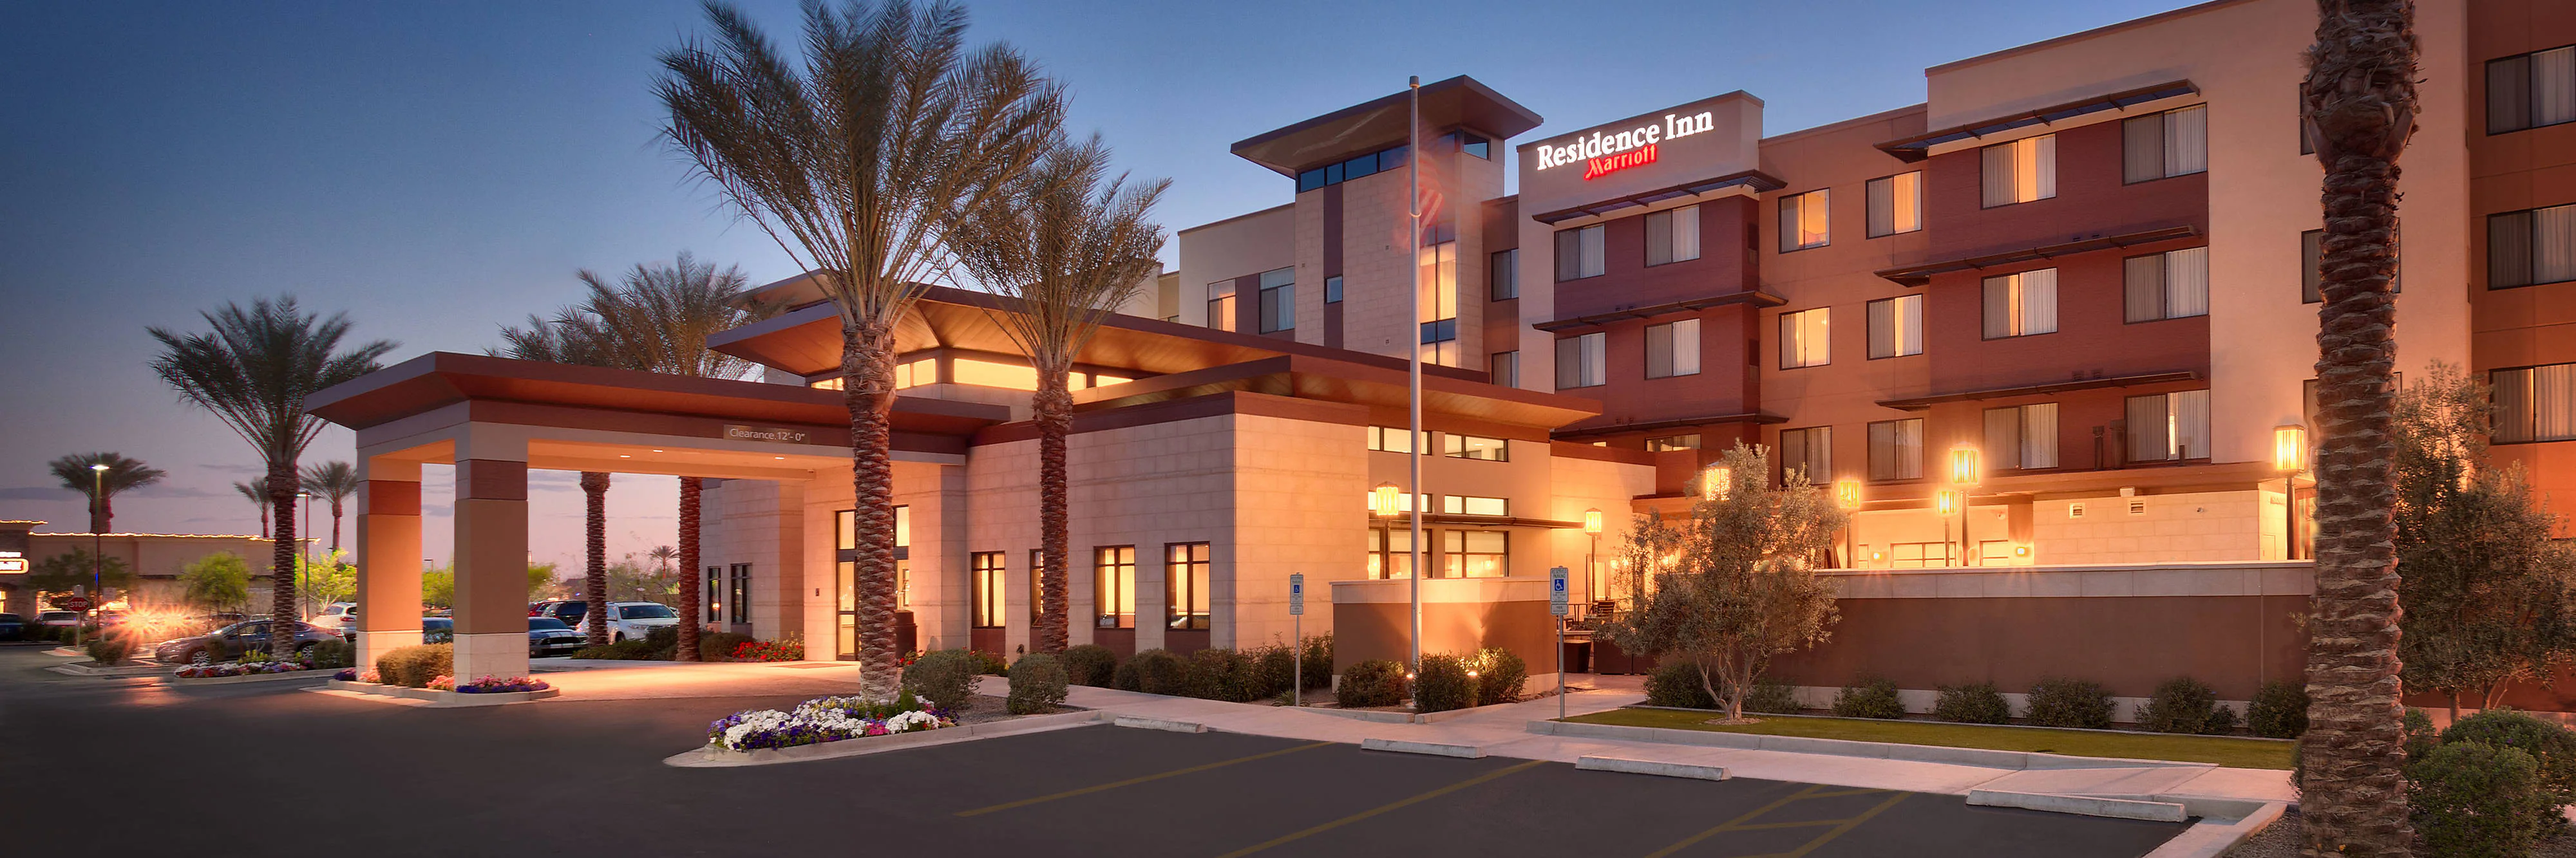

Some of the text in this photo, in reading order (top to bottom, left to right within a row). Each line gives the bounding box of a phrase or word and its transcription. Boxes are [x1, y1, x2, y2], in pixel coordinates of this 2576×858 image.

[1537, 111, 1714, 171] Residence Inn
[1585, 144, 1656, 180] Marriott
